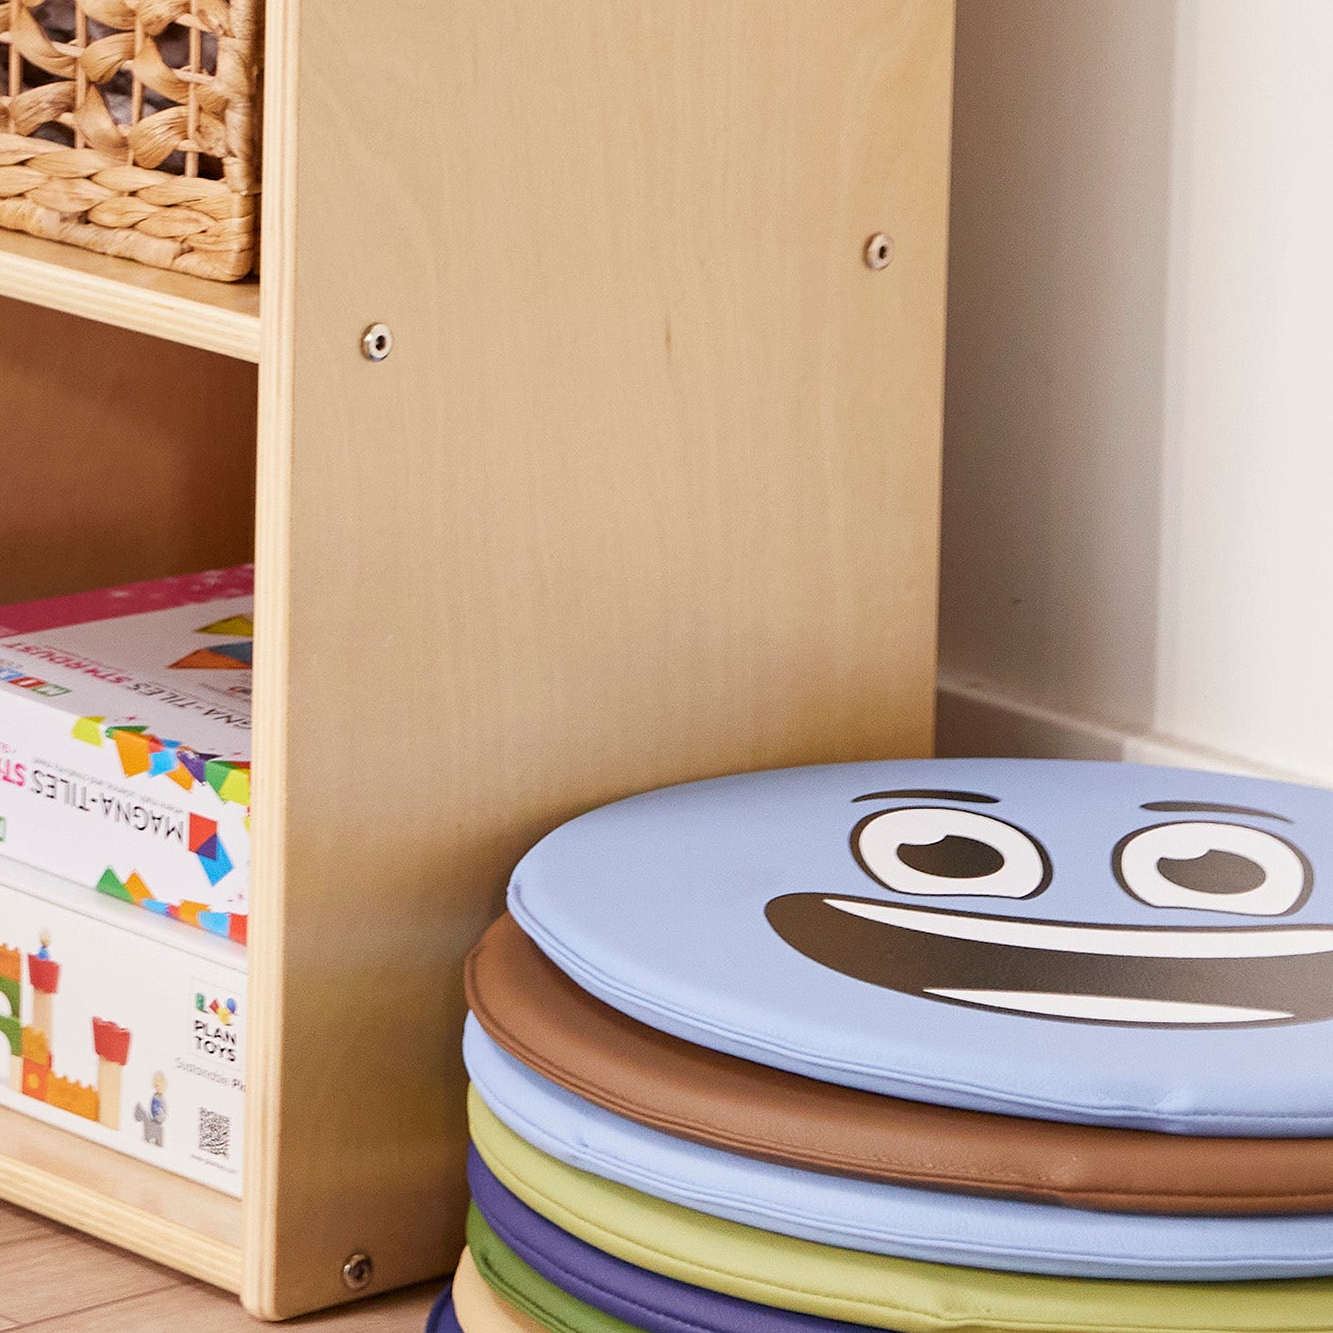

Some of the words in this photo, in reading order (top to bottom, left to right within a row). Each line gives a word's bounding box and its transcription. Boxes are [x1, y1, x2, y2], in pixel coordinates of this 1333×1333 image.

[32, 769, 184, 843] MAGNA-TILES
[195, 1019, 237, 1045] PLAN
[195, 1036, 236, 1061] TOYS
